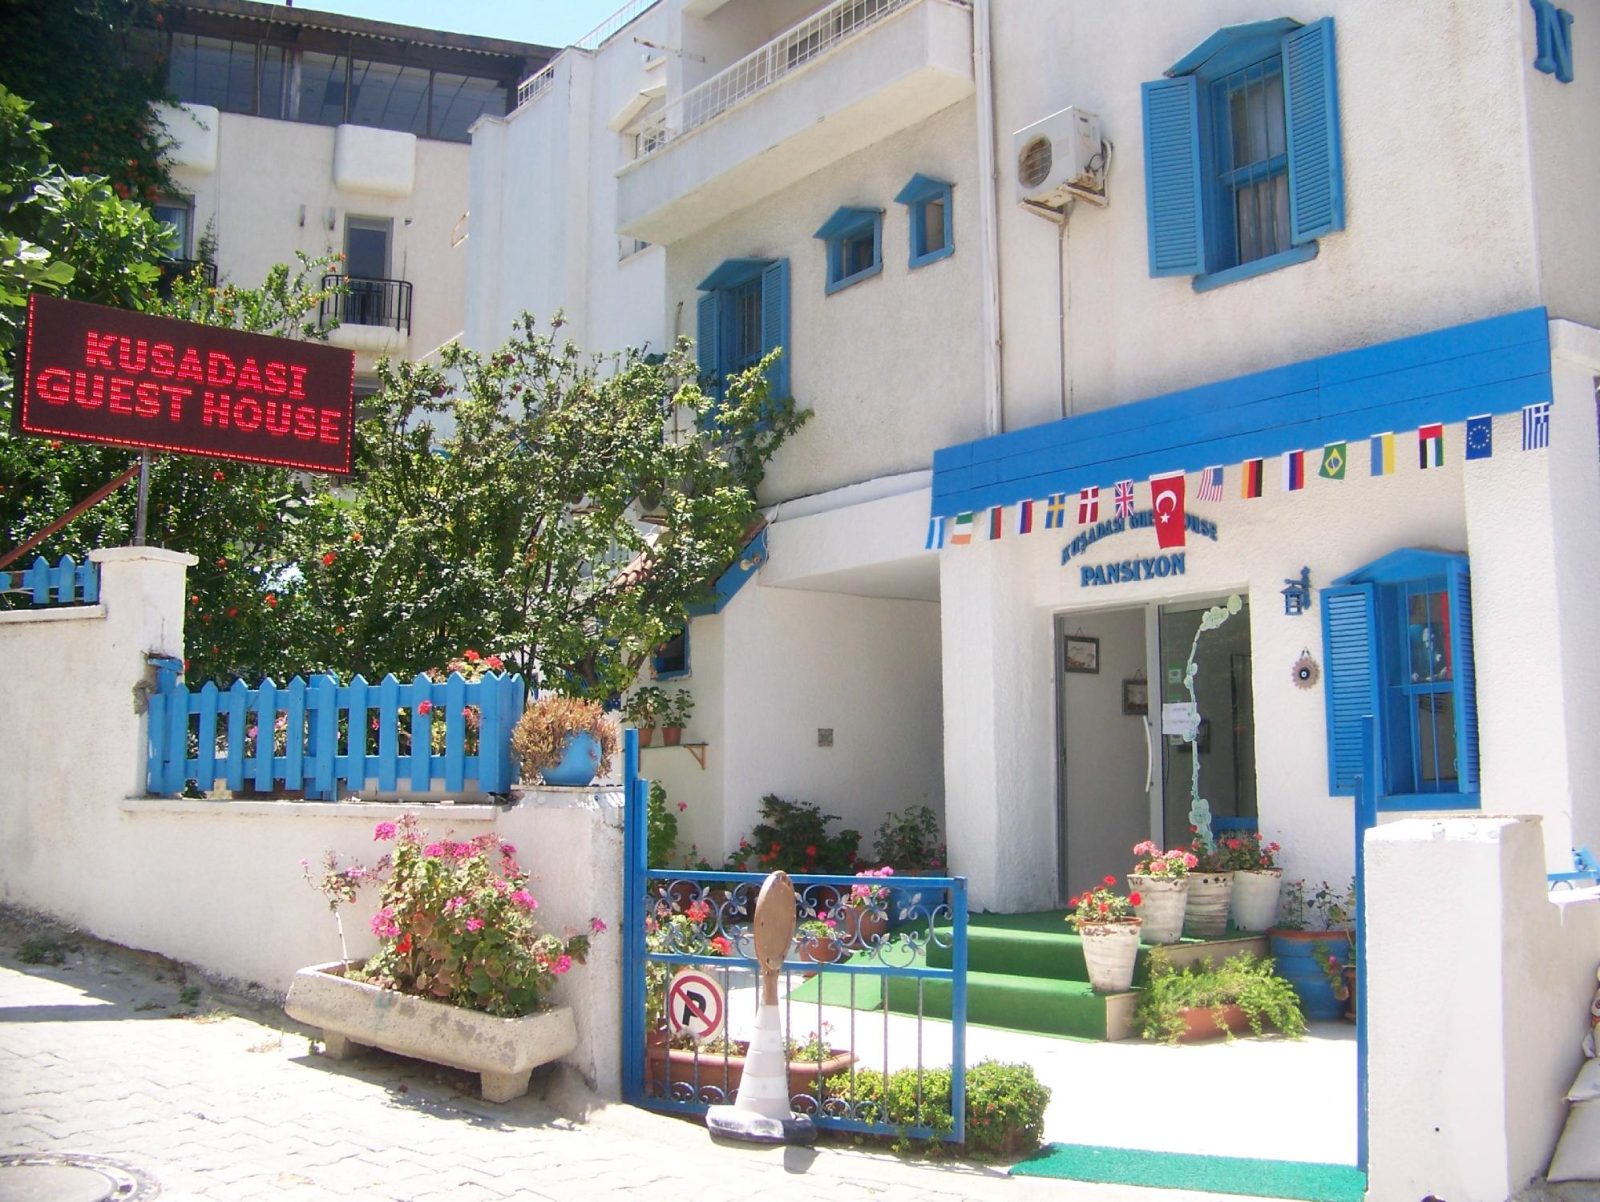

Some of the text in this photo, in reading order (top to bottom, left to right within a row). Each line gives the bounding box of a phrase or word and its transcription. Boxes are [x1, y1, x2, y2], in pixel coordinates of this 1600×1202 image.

[85, 330, 308, 399] KUSADASI
[35, 367, 342, 443] GUEST HOUSE
[1130, 510, 1156, 530] GUE
